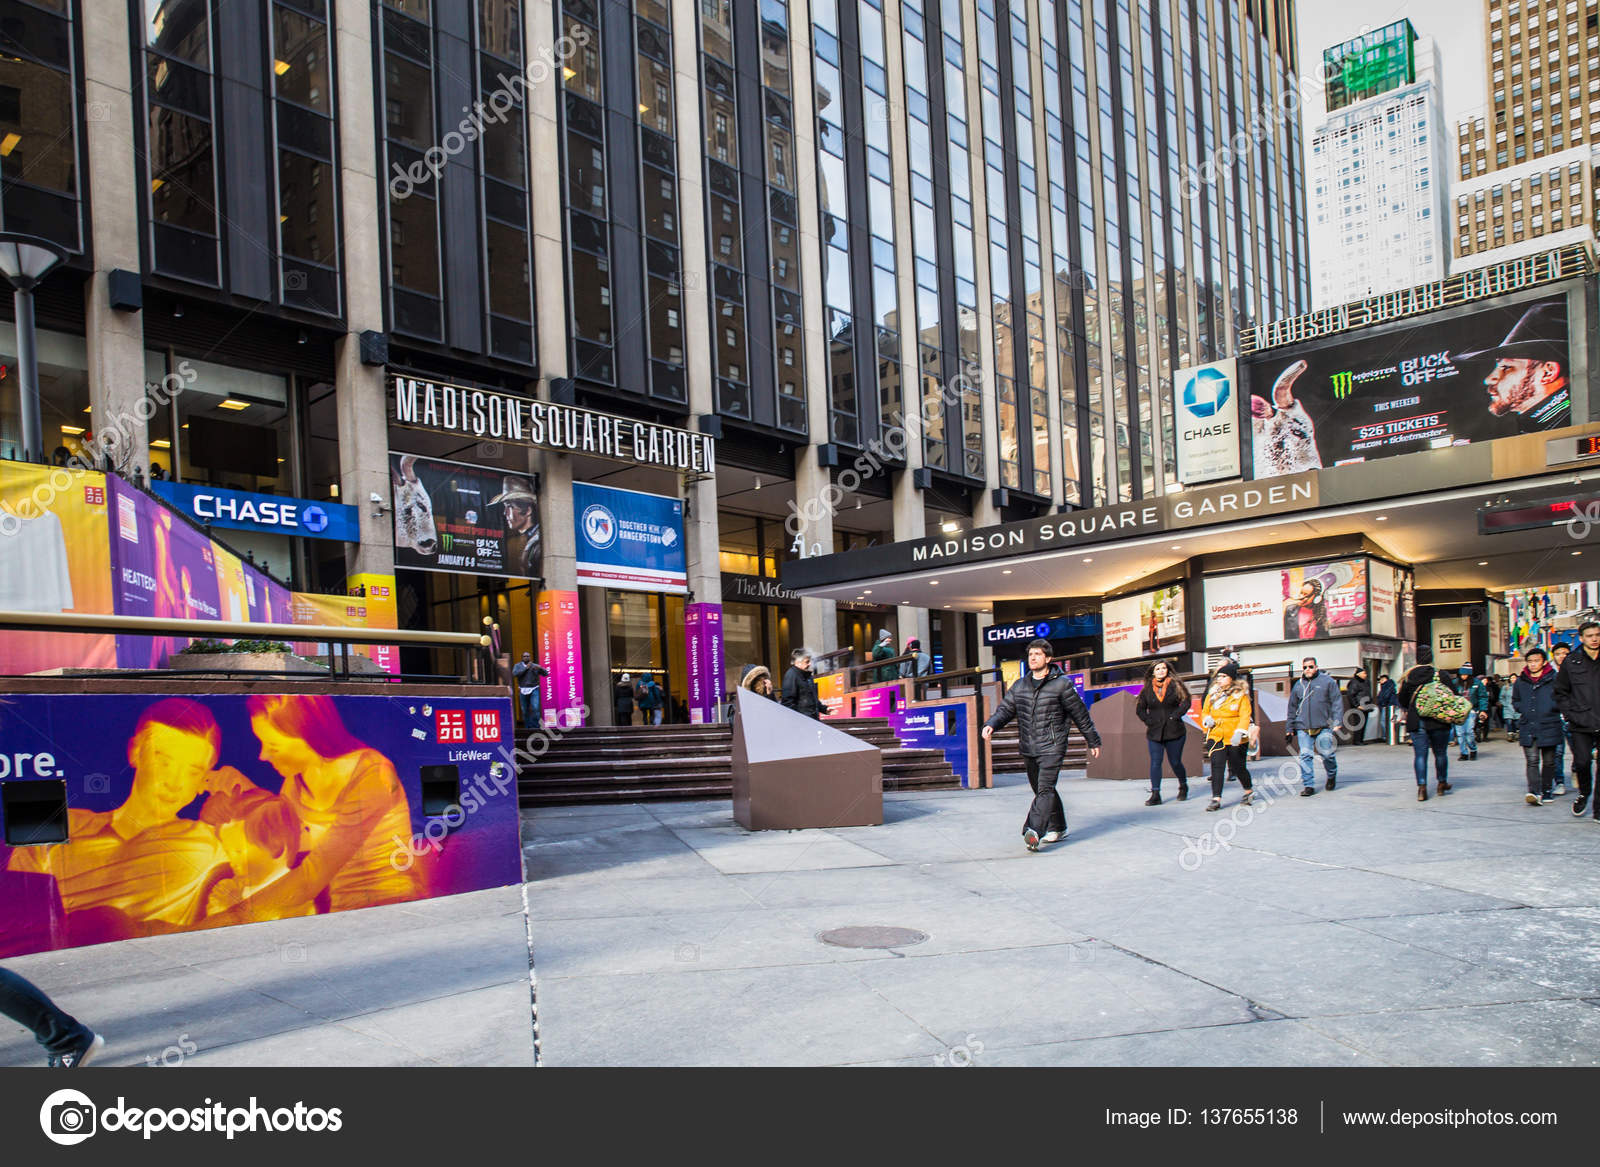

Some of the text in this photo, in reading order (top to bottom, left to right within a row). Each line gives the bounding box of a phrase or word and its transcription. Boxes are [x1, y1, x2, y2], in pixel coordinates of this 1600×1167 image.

[1255, 249, 1562, 351] MADISON SQUARE GARDEN
[1400, 350, 1451, 374] BUCK
[1401, 368, 1437, 386] OFF
[1374, 396, 1420, 412] THIS WEEKEND
[395, 377, 715, 473] MADISON SQUARE GARDEN
[1184, 423, 1231, 441] CHASE
[1360, 415, 1439, 440] $26 TICKETS
[194, 494, 298, 527] CHASE
[619, 520, 647, 532] TOGETHER
[912, 480, 1312, 562] MADISON SQUARE GARDEN
[619, 530, 661, 544] RANGERSTOWN
[438, 554, 464, 566] JANUARY
[477, 548, 492, 557] OFF
[122, 568, 157, 592] HEATTECH
[736, 578, 756, 596] The
[1211, 602, 1243, 614] Upgrade
[1328, 593, 1355, 608] LTE
[1212, 608, 1274, 620] understatement.
[988, 626, 1035, 641] CHASE
[1439, 638, 1462, 650] LTE
[568, 666, 575, 674] to
[475, 714, 496, 725] UNI
[475, 727, 498, 740] QLO
[448, 750, 493, 762] LifeWear
